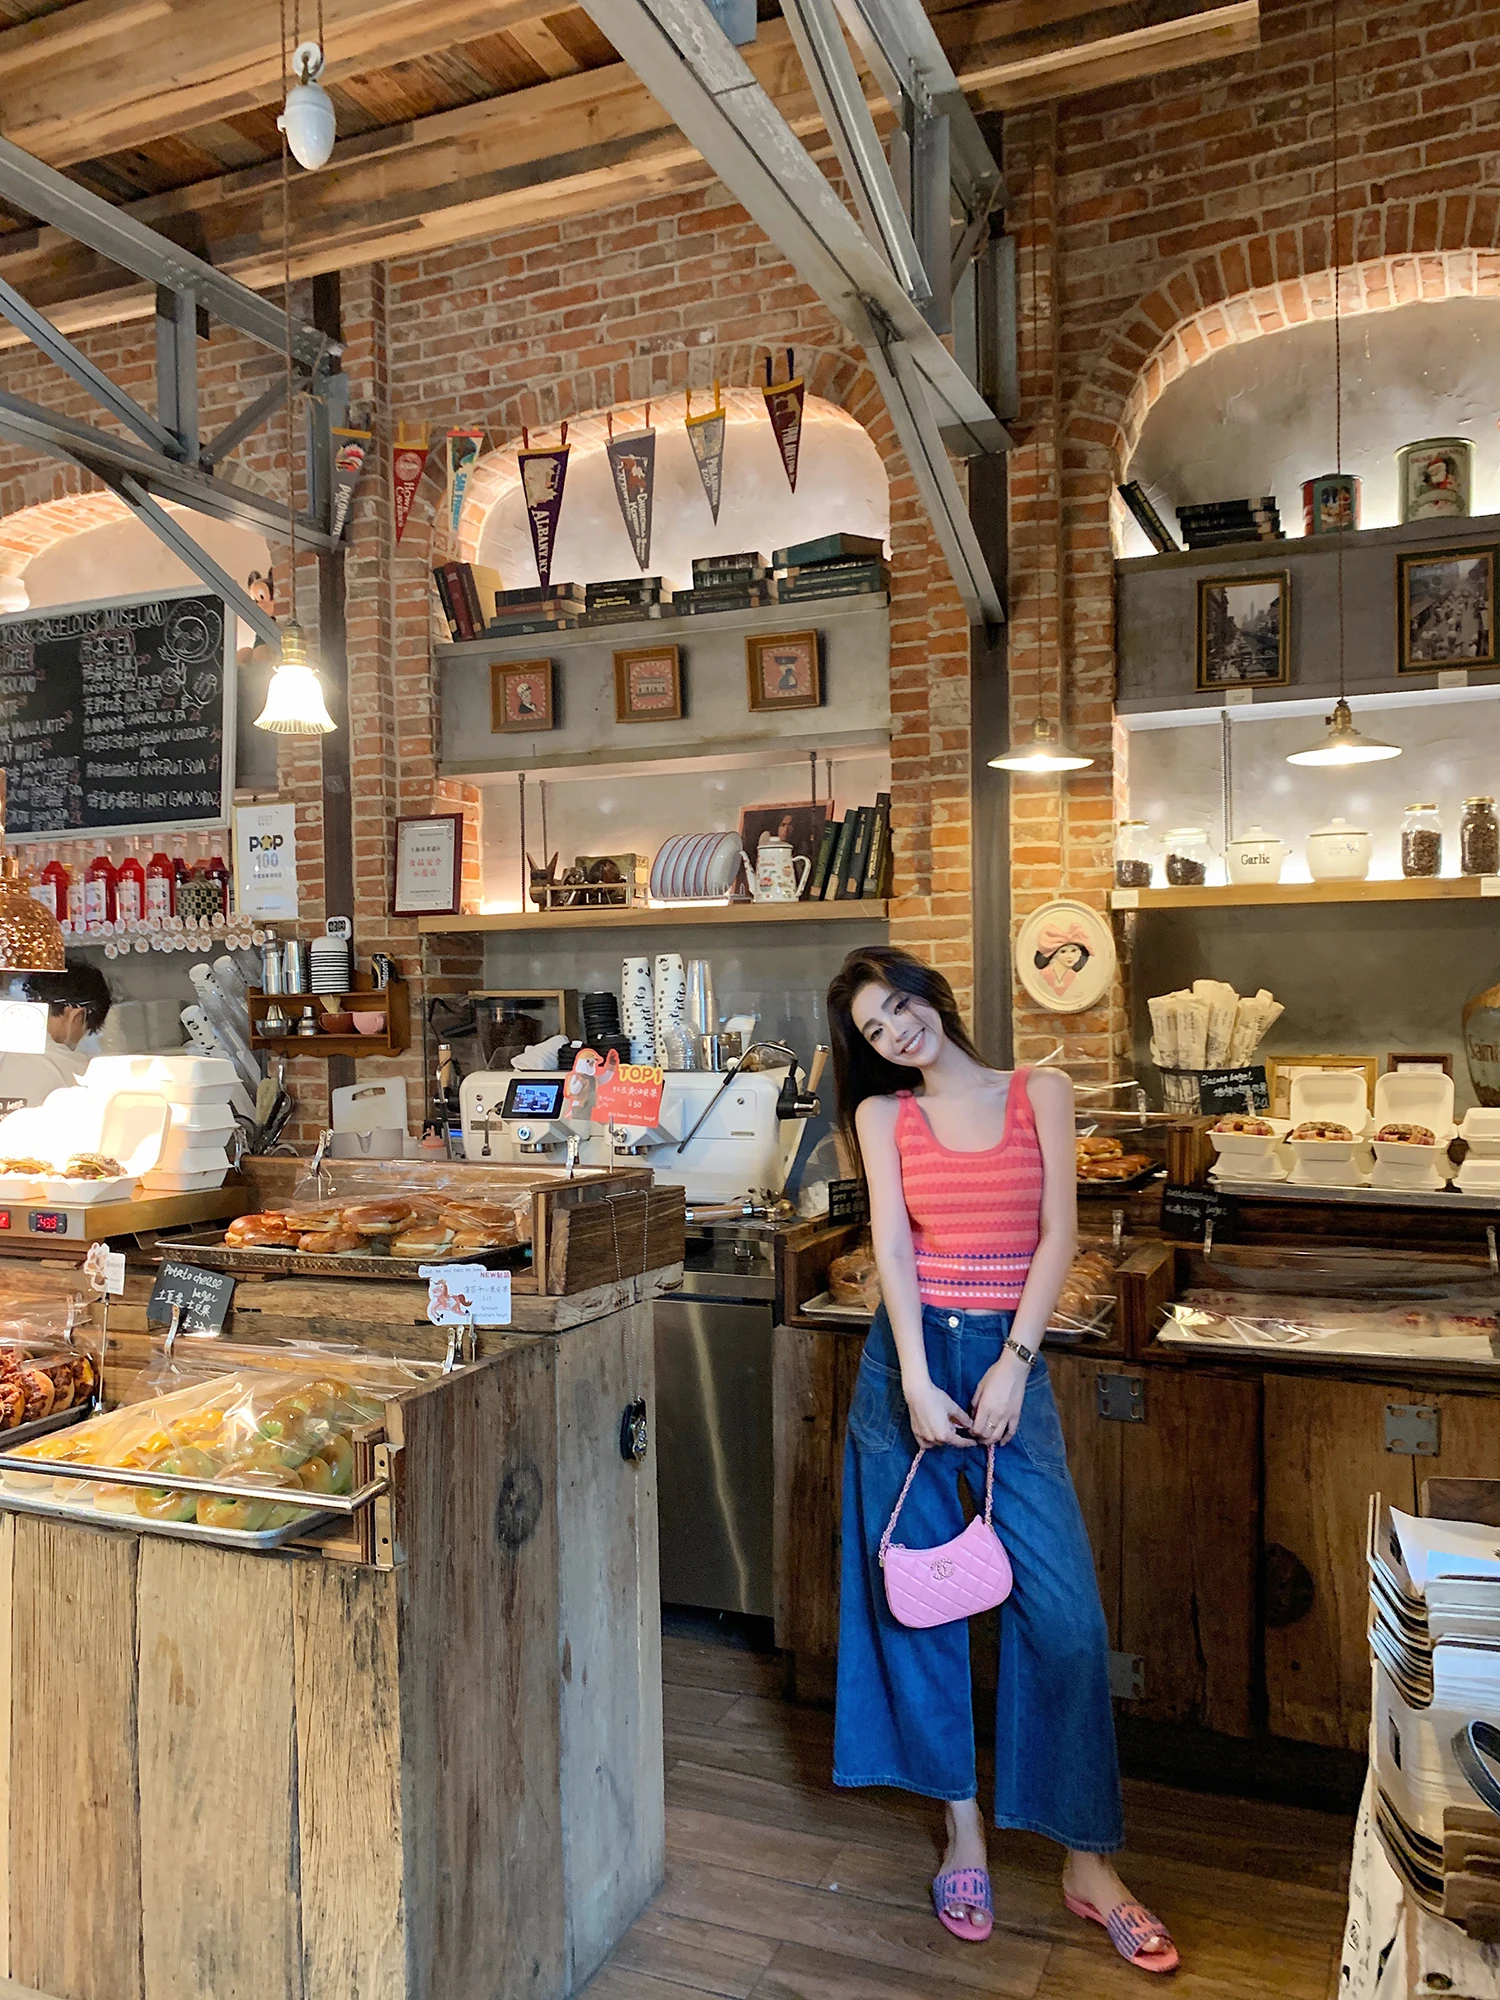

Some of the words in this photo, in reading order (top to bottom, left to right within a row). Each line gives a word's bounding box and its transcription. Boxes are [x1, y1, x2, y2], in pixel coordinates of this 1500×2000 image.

[455, 473, 467, 492] SAN
[701, 468, 712, 487] ZOO
[256, 853, 279, 868] 100
[1240, 853, 1270, 866] Garlic
[619, 1065, 663, 1085] TOP1
[164, 1263, 193, 1281] Potato
[192, 1272, 223, 1290] cheese
